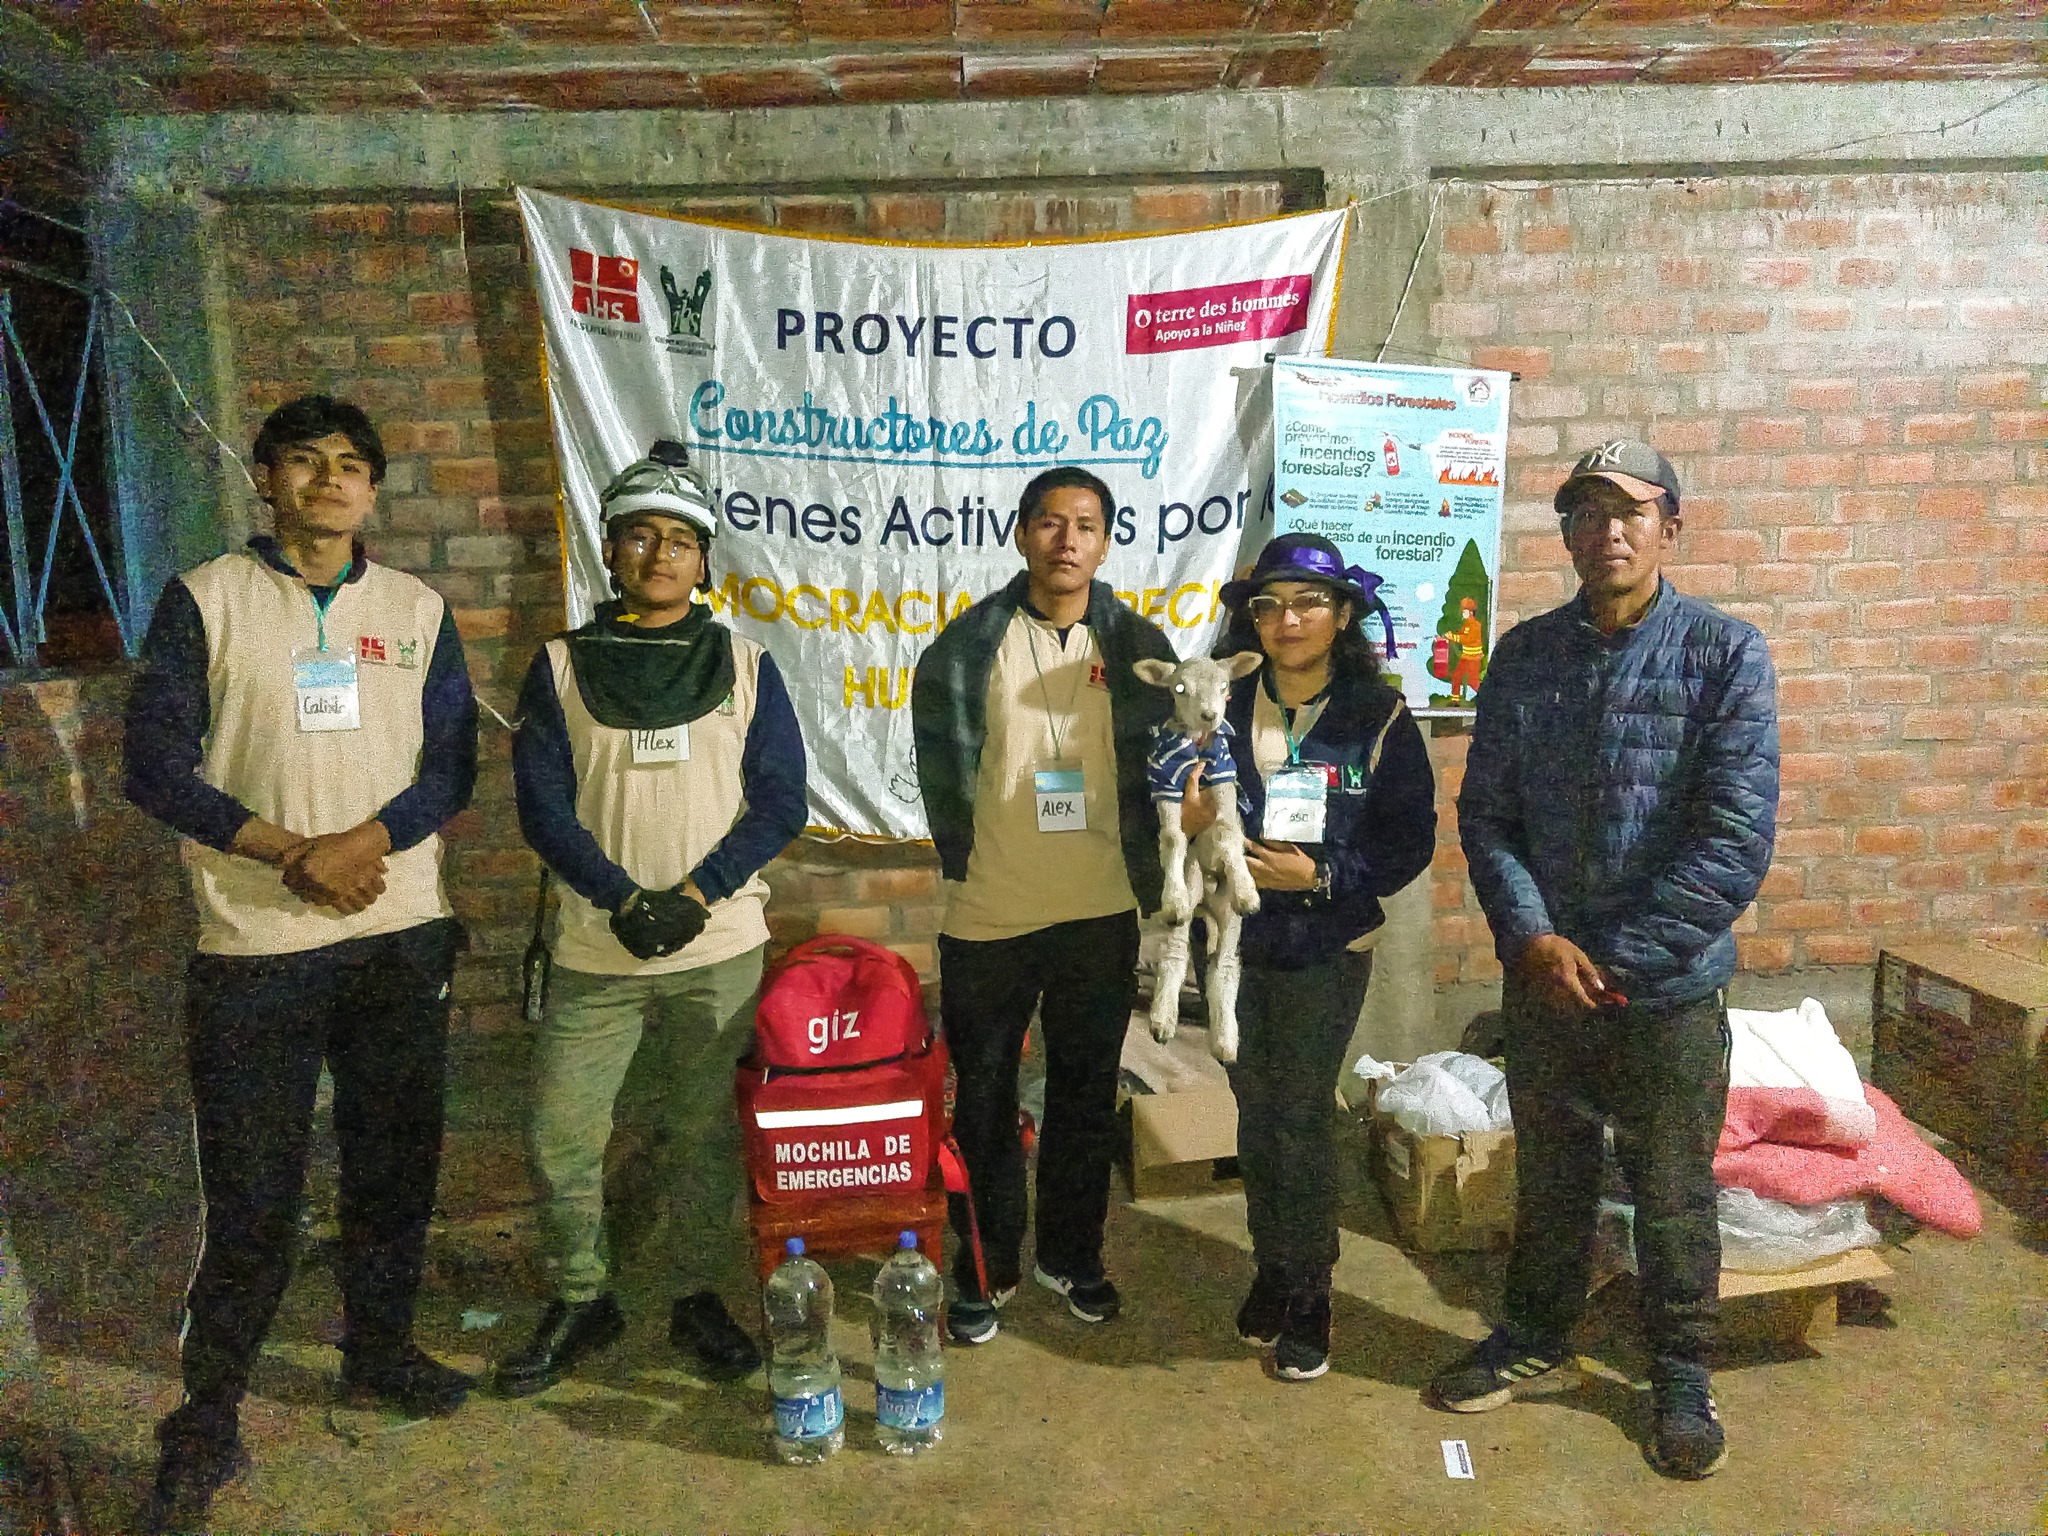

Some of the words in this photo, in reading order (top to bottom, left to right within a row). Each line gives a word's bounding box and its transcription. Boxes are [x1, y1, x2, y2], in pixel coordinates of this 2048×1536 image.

[1156, 307, 1195, 323] terre
[1200, 300, 1226, 317] des
[1231, 292, 1300, 313] hommes
[777, 307, 1076, 359] PROYECTO
[1155, 329, 1190, 343] Apoyo
[1193, 328, 1200, 337] a
[1202, 324, 1212, 336] la
[1215, 320, 1246, 334] Niñez
[688, 380, 1003, 457] Constructores
[1013, 401, 1066, 455] de
[1077, 393, 1168, 480] Paz
[1281, 459, 1371, 478] forestales?
[1299, 444, 1376, 463] incendios
[714, 488, 862, 546] enes
[880, 495, 1136, 547] Activs
[1157, 489, 1251, 554] por
[1321, 520, 1354, 532] hacer
[1357, 531, 1373, 543] de
[1376, 534, 1391, 544] un
[1393, 530, 1456, 547] incendio
[1376, 545, 1443, 562] forestal?
[808, 1009, 860, 1055] giz
[775, 1138, 870, 1164] MOCHILA
[884, 1134, 911, 1156] DE
[776, 1161, 912, 1191] EMERGENCIAS
